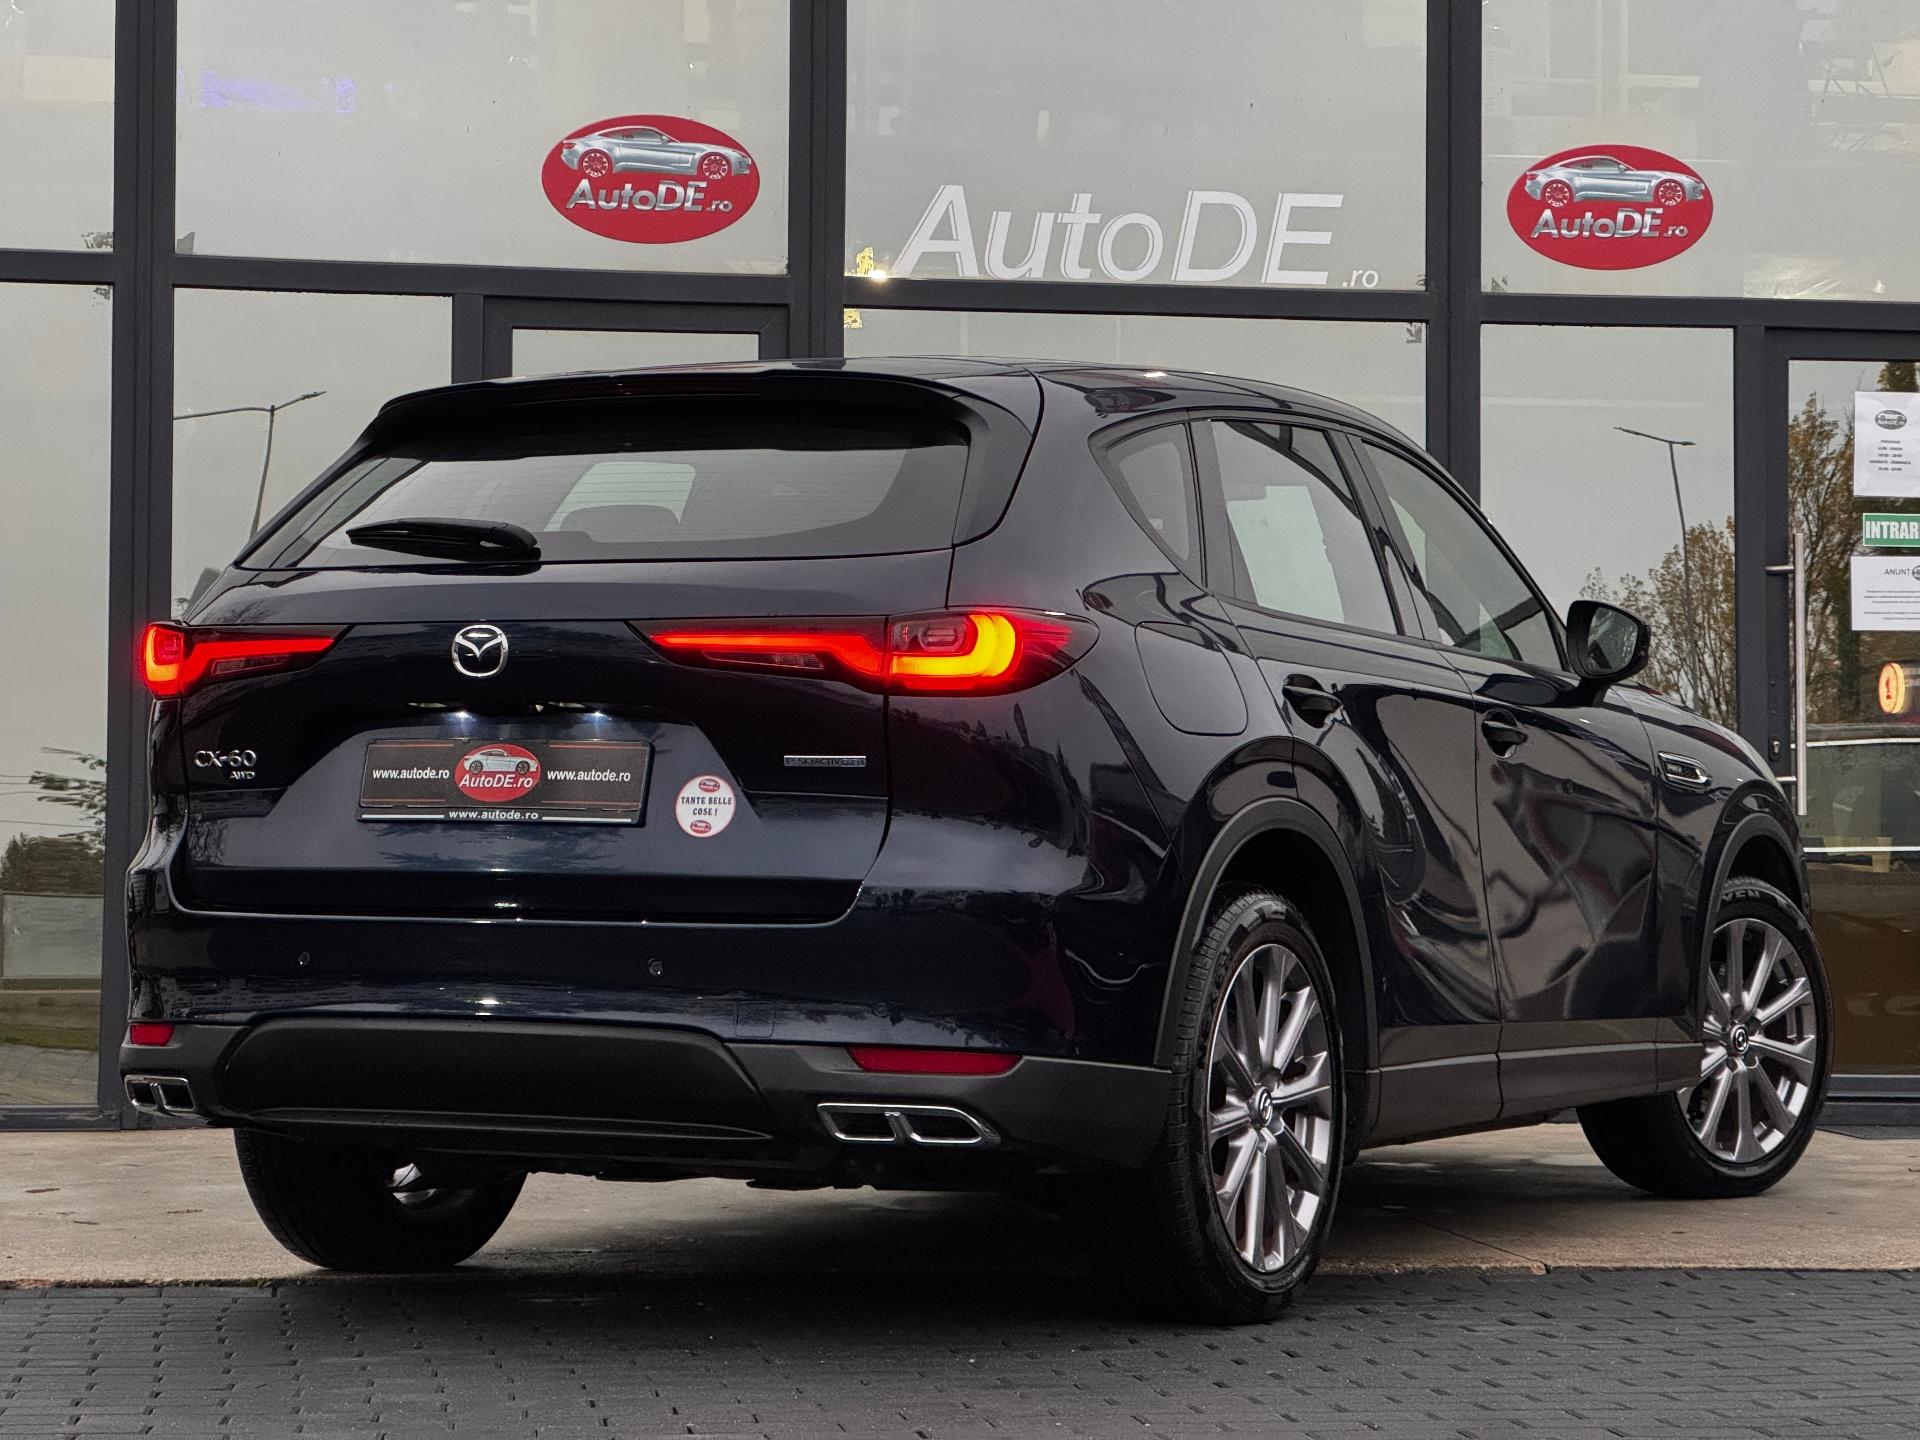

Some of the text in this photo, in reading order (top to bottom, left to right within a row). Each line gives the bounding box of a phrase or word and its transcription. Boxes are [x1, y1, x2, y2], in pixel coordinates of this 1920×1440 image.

[194, 749, 257, 768] CX-60
[229, 771, 256, 780] AWD
[372, 766, 450, 780] www.autode.ro
[547, 768, 631, 782] www.autode.ro
[458, 773, 534, 789] AutoDE.ro
[681, 796, 733, 805] TANTE BELLE
[449, 810, 539, 820] www.autode.ro
[693, 807, 713, 816] COSE
